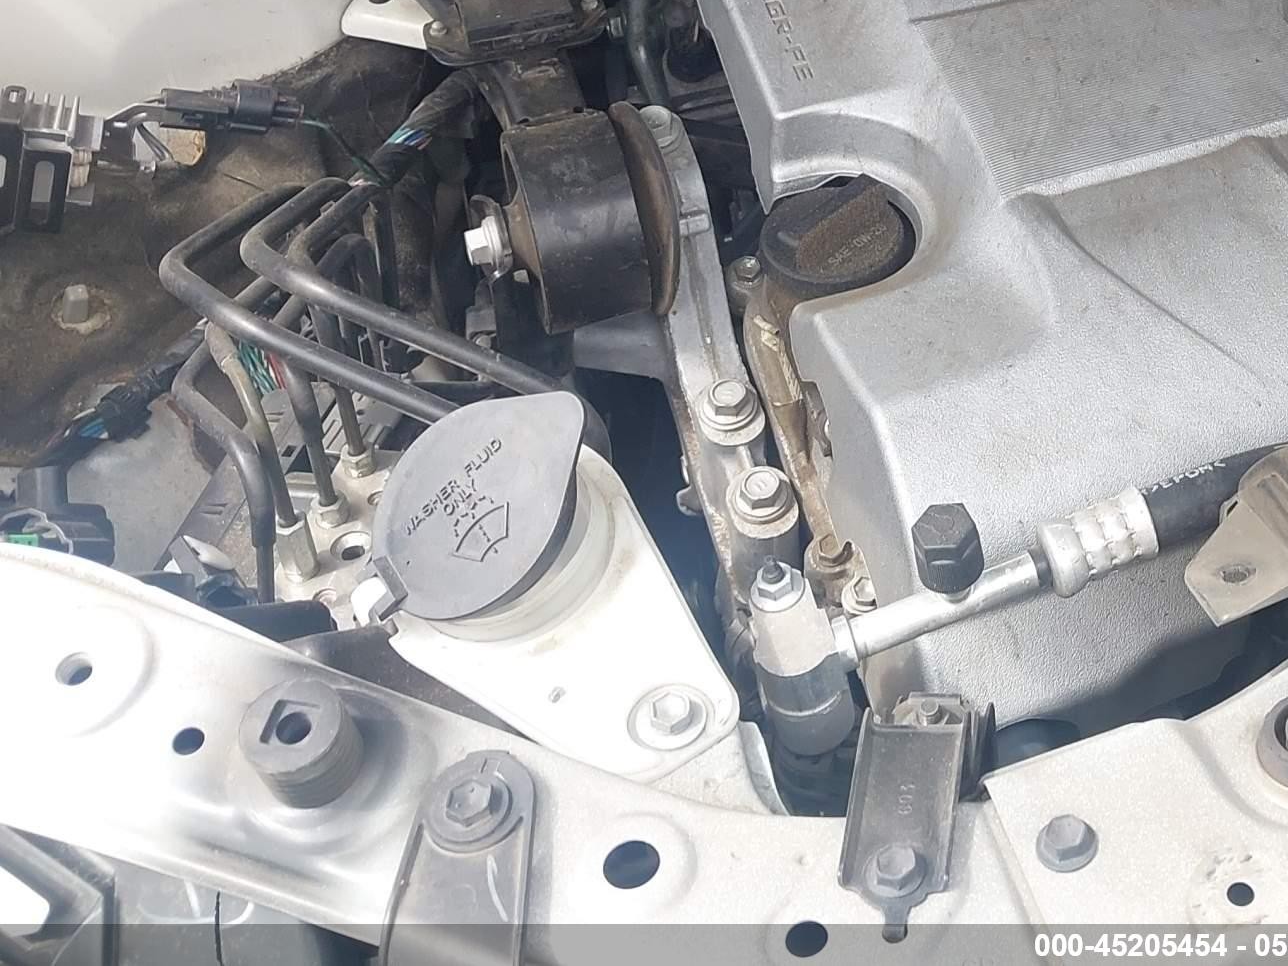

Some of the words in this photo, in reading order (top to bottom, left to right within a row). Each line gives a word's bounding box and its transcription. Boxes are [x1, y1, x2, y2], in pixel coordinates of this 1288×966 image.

[405, 479, 460, 535] WASHER
[464, 437, 503, 479] FLUID
[443, 478, 481, 517] ONLY
